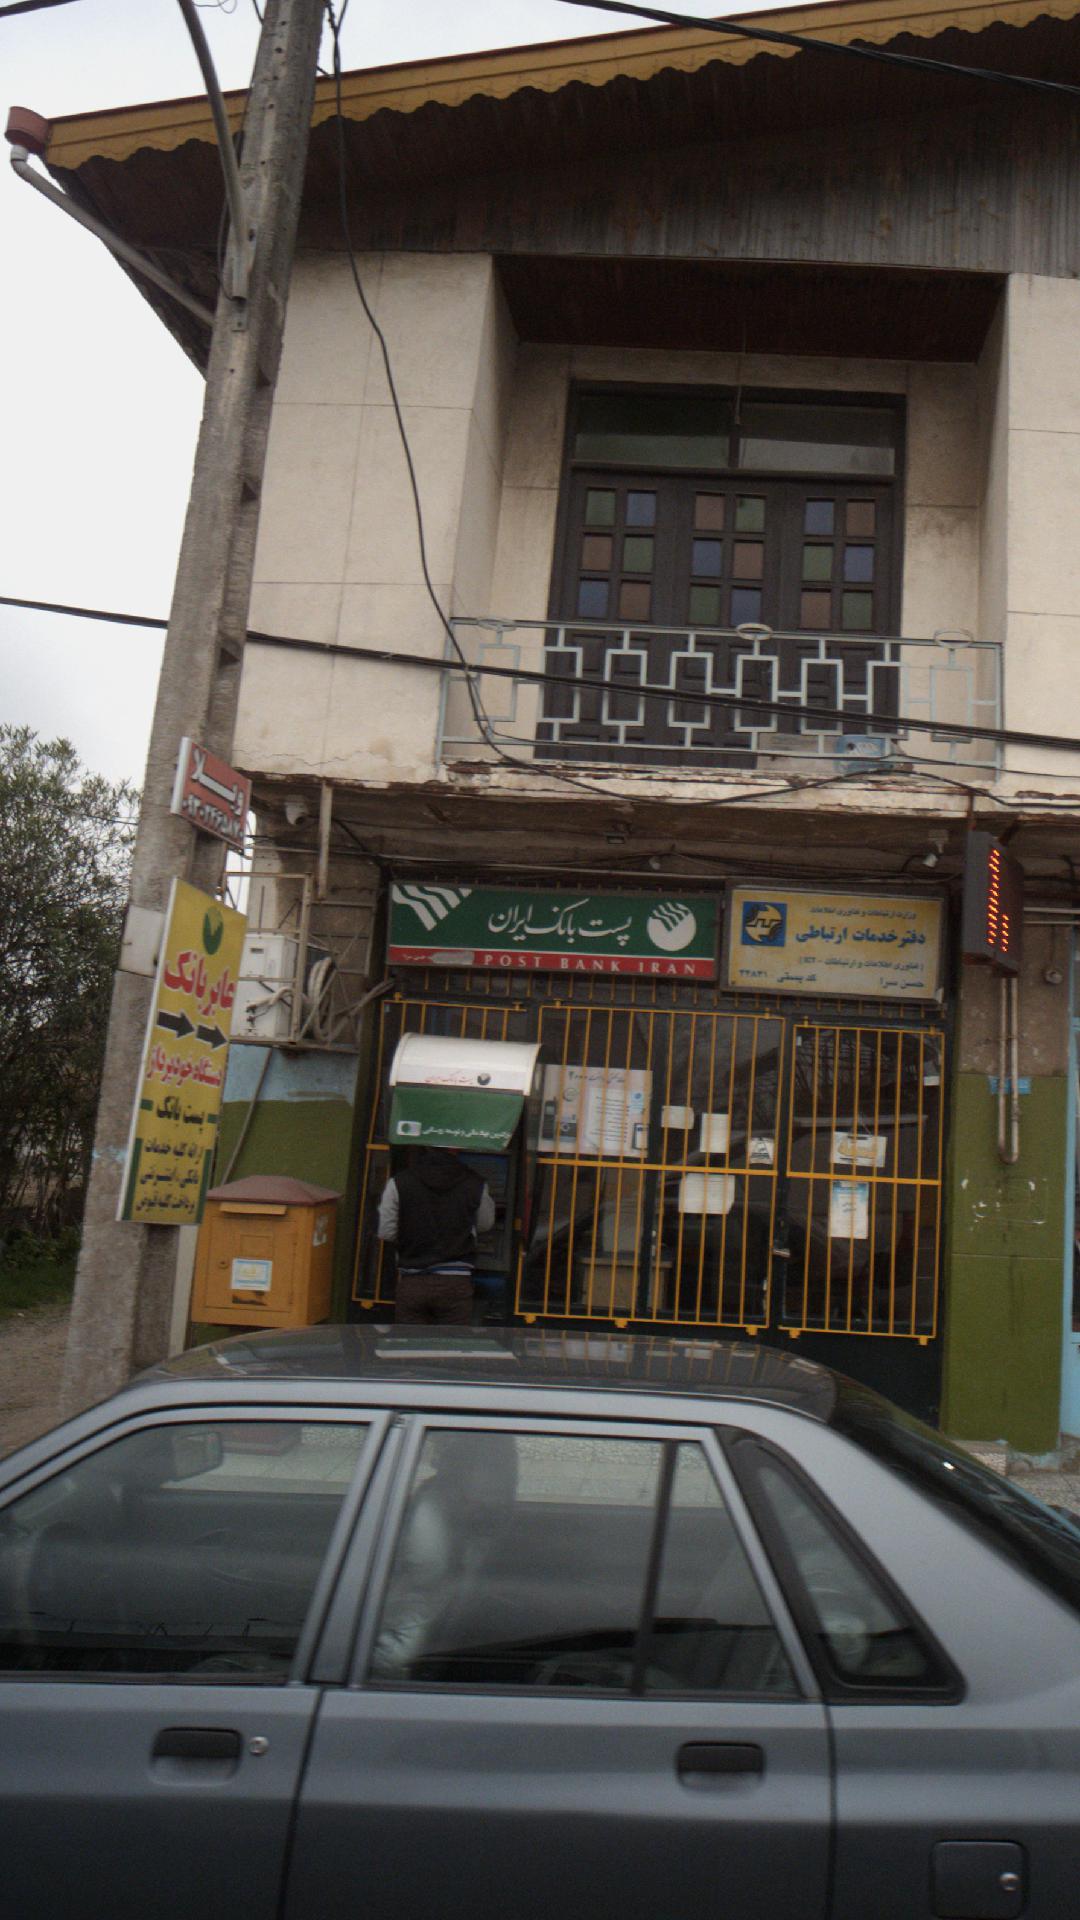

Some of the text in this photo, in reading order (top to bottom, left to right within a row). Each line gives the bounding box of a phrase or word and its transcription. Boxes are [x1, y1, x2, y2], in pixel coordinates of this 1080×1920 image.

[191, 747, 244, 817] ویلا
[487, 896, 633, 947] پست بانک ایران
[795, 925, 926, 948] دفتر خدمات ارتباطی
[163, 950, 238, 1017] عابر بانک
[483, 953, 696, 975] POST BANK IRAN
[776, 970, 804, 984] پستی
[156, 1094, 205, 1134] پست بانک
